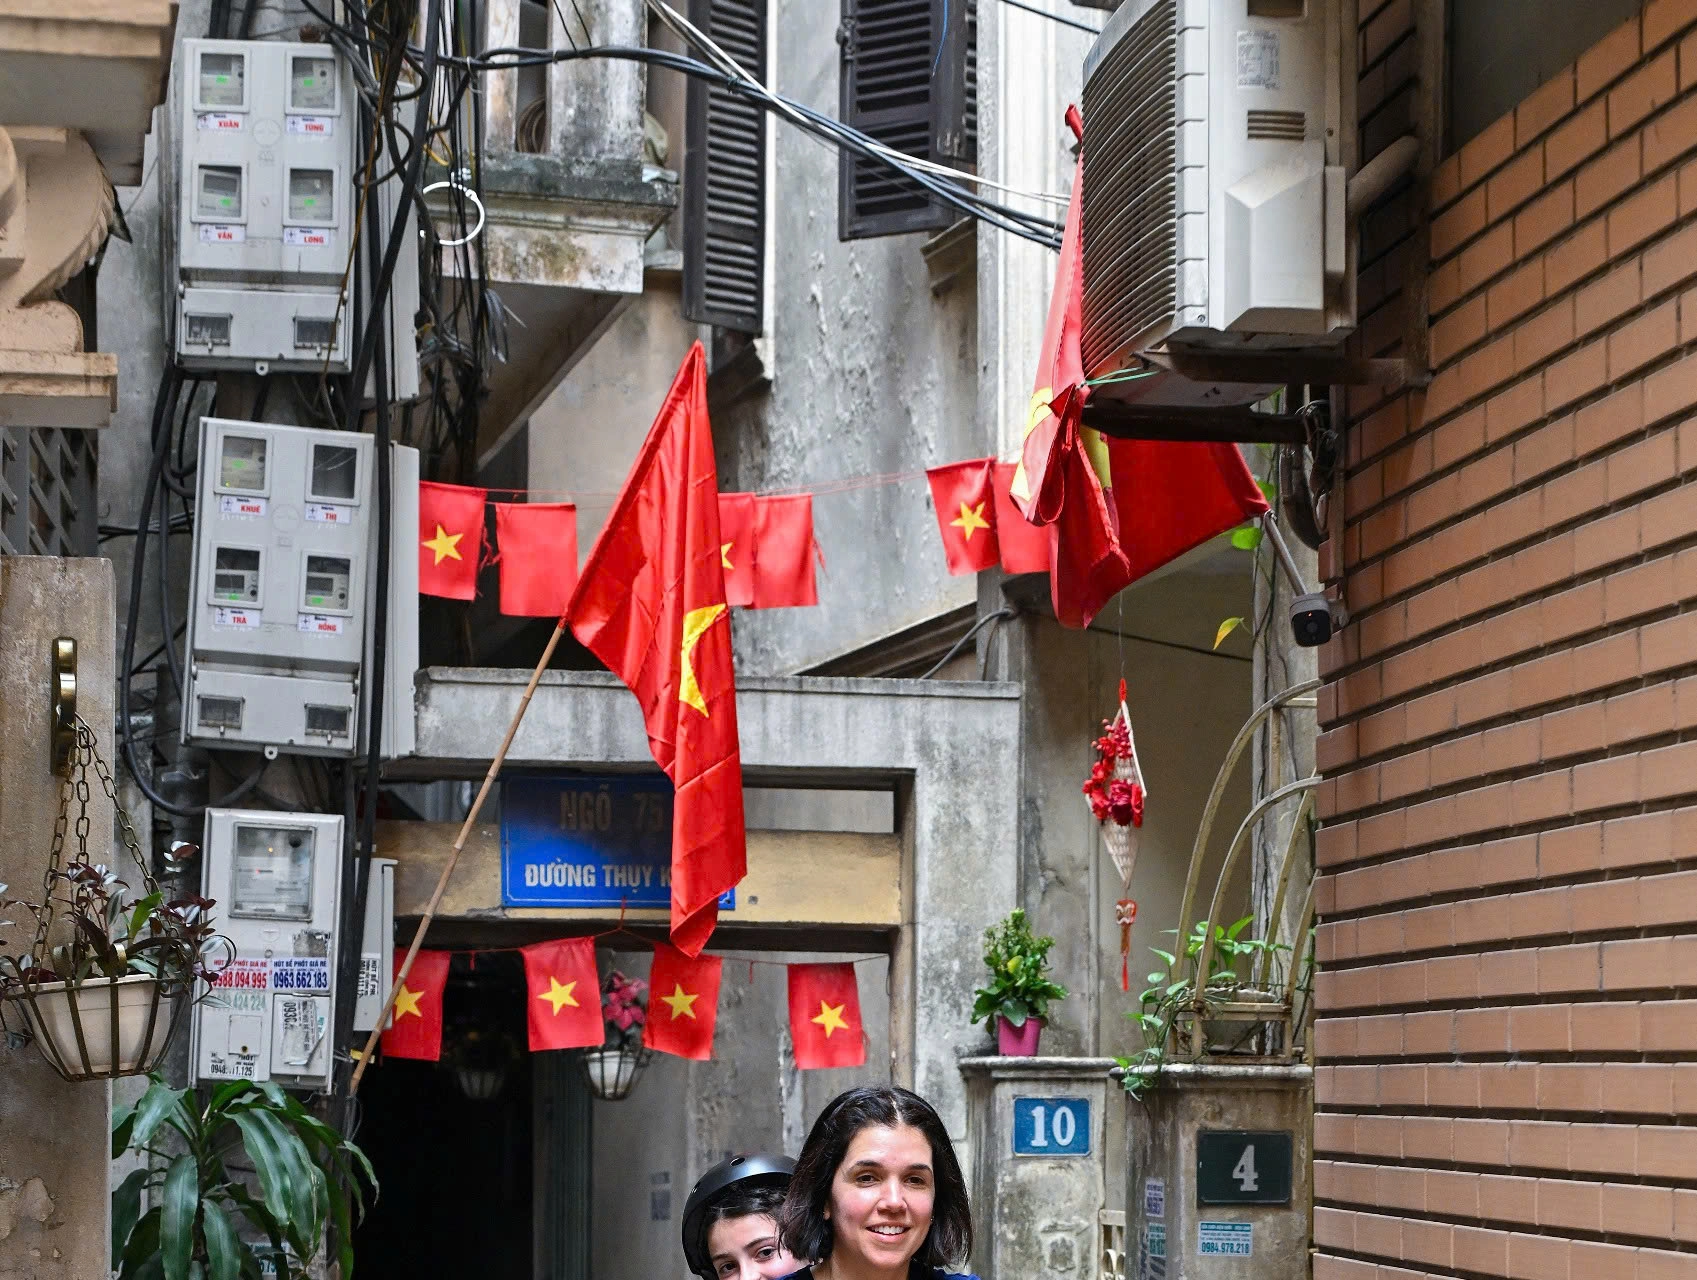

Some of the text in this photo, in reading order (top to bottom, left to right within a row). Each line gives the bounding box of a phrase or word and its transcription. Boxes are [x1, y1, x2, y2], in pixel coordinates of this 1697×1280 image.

[524, 857, 596, 888] ĐƯỜNG
[602, 863, 657, 893] THỤY
[1031, 1105, 1076, 1148] 10
[1232, 1145, 1259, 1192] 4
